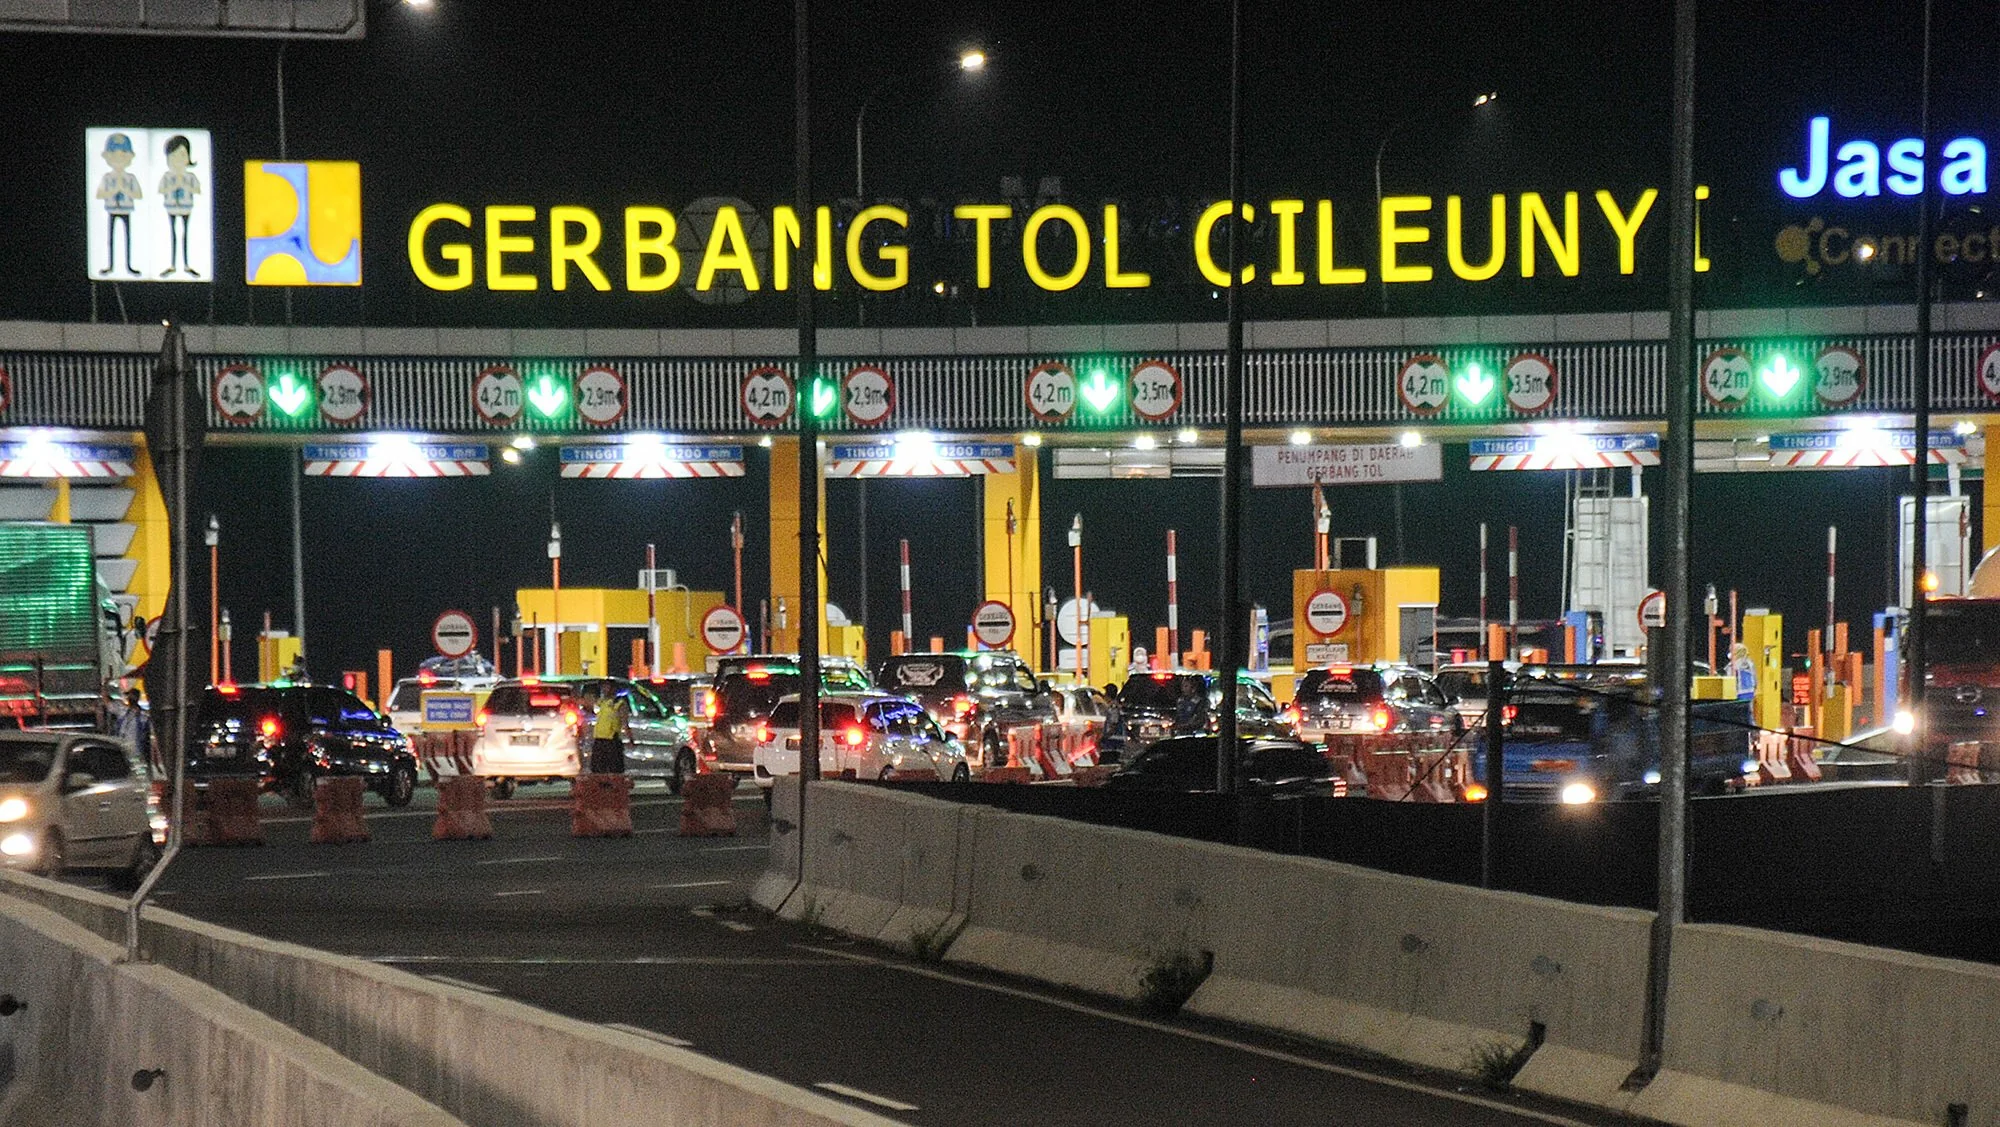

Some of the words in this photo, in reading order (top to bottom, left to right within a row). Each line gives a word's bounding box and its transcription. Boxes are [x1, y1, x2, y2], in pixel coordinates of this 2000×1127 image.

[1779, 116, 1988, 199] Jasa
[407, 203, 909, 292] GERBANG
[954, 200, 1152, 290] TOL
[1405, 375, 1445, 398] 4,2m
[1709, 368, 1749, 392] 4,2m
[480, 386, 520, 409] 4,2m
[748, 387, 788, 409] 4,2m
[1033, 383, 1072, 405] 4,2m
[1483, 440, 1529, 453] TINGGI
[1783, 436, 1830, 448] TINGGI
[317, 447, 362, 459] TINGGI
[573, 448, 618, 460] TINGGI
[708, 449, 731, 459] mm
[845, 447, 890, 459] TINGGI
[979, 447, 1003, 457] mm
[1278, 449, 1346, 464] PENUMPANG
[1353, 449, 1364, 461] DI
[1307, 465, 1360, 480] GERBANG
[1364, 464, 1384, 478] TOL
